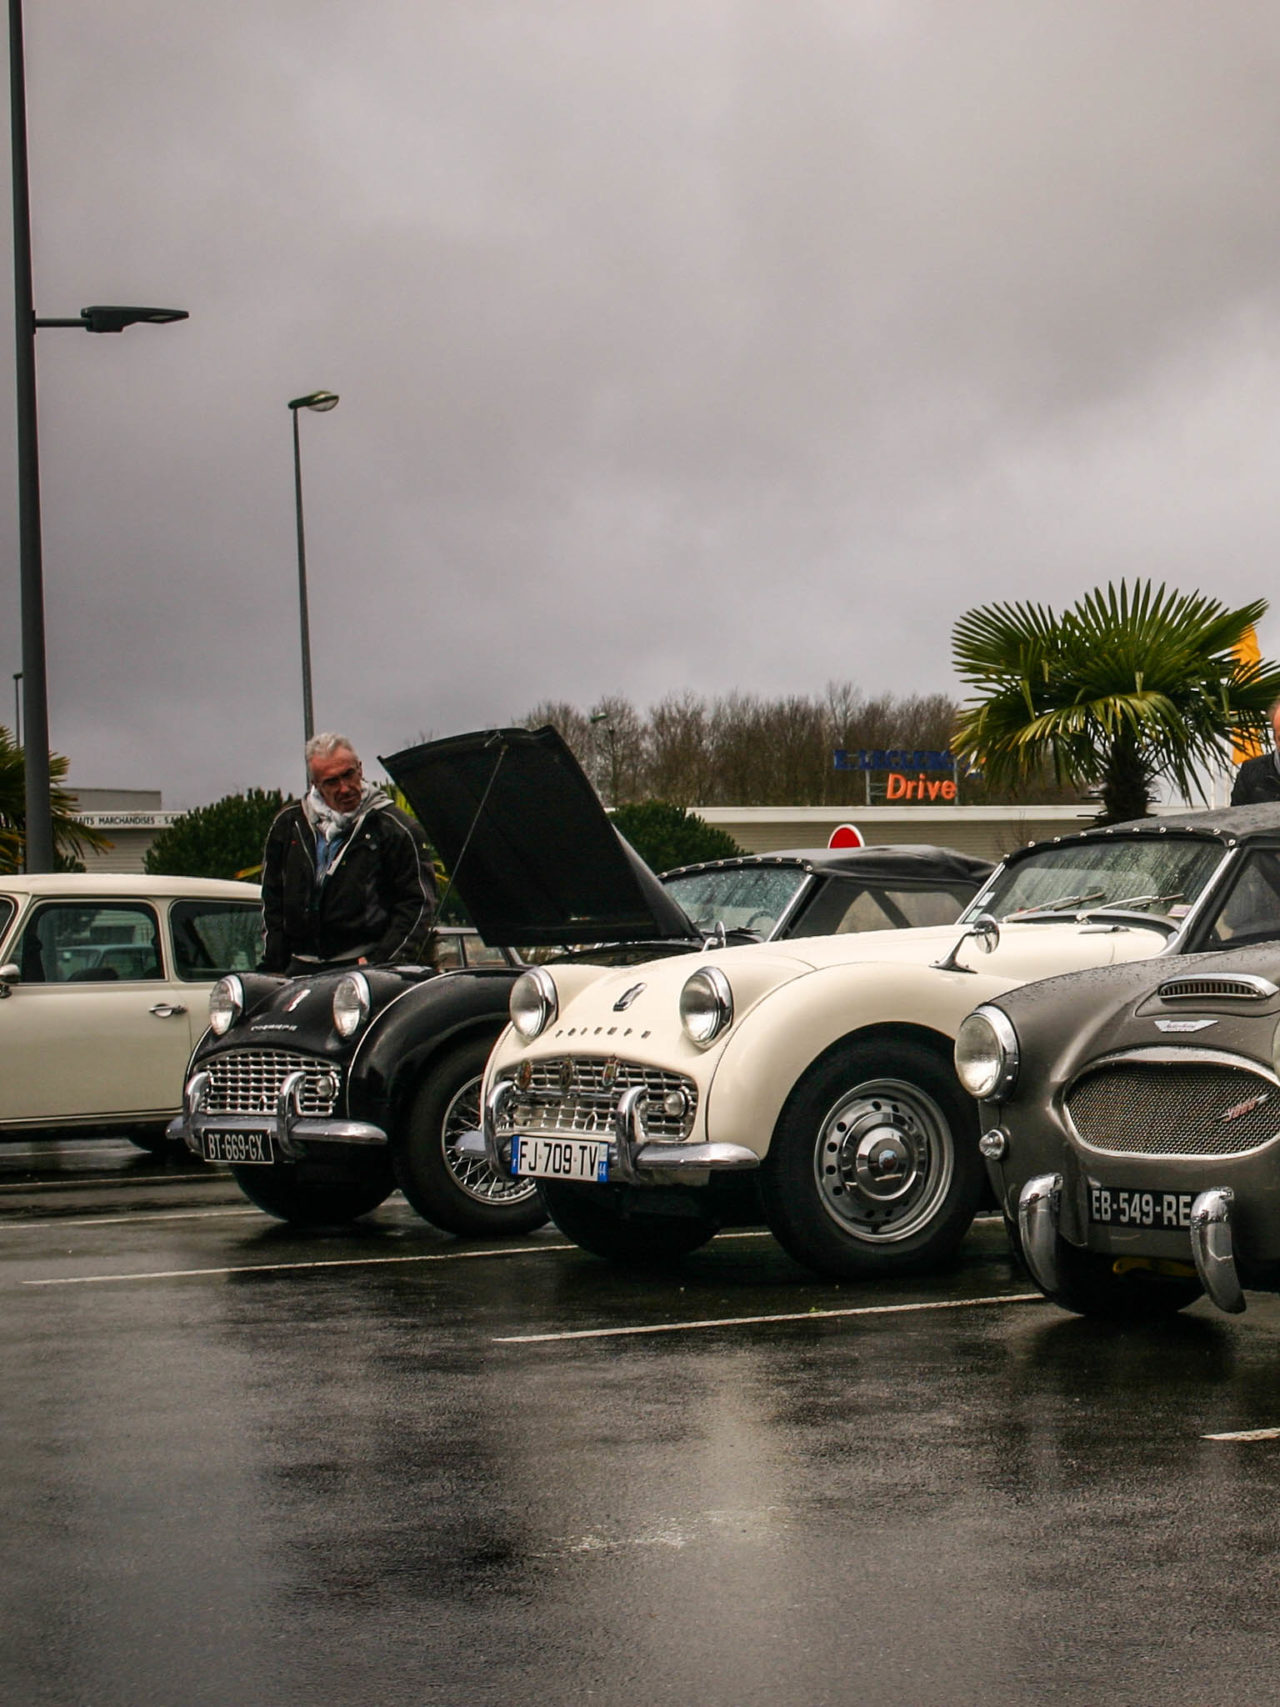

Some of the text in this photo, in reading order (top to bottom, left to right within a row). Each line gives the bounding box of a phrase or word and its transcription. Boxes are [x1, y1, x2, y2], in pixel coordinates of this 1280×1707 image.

[886, 772, 957, 800] Drive
[99, 815, 155, 826] MARCHANDISES
[208, 1133, 265, 1161] BT-669-GX
[1092, 1189, 1192, 1227] EB-549-RE
